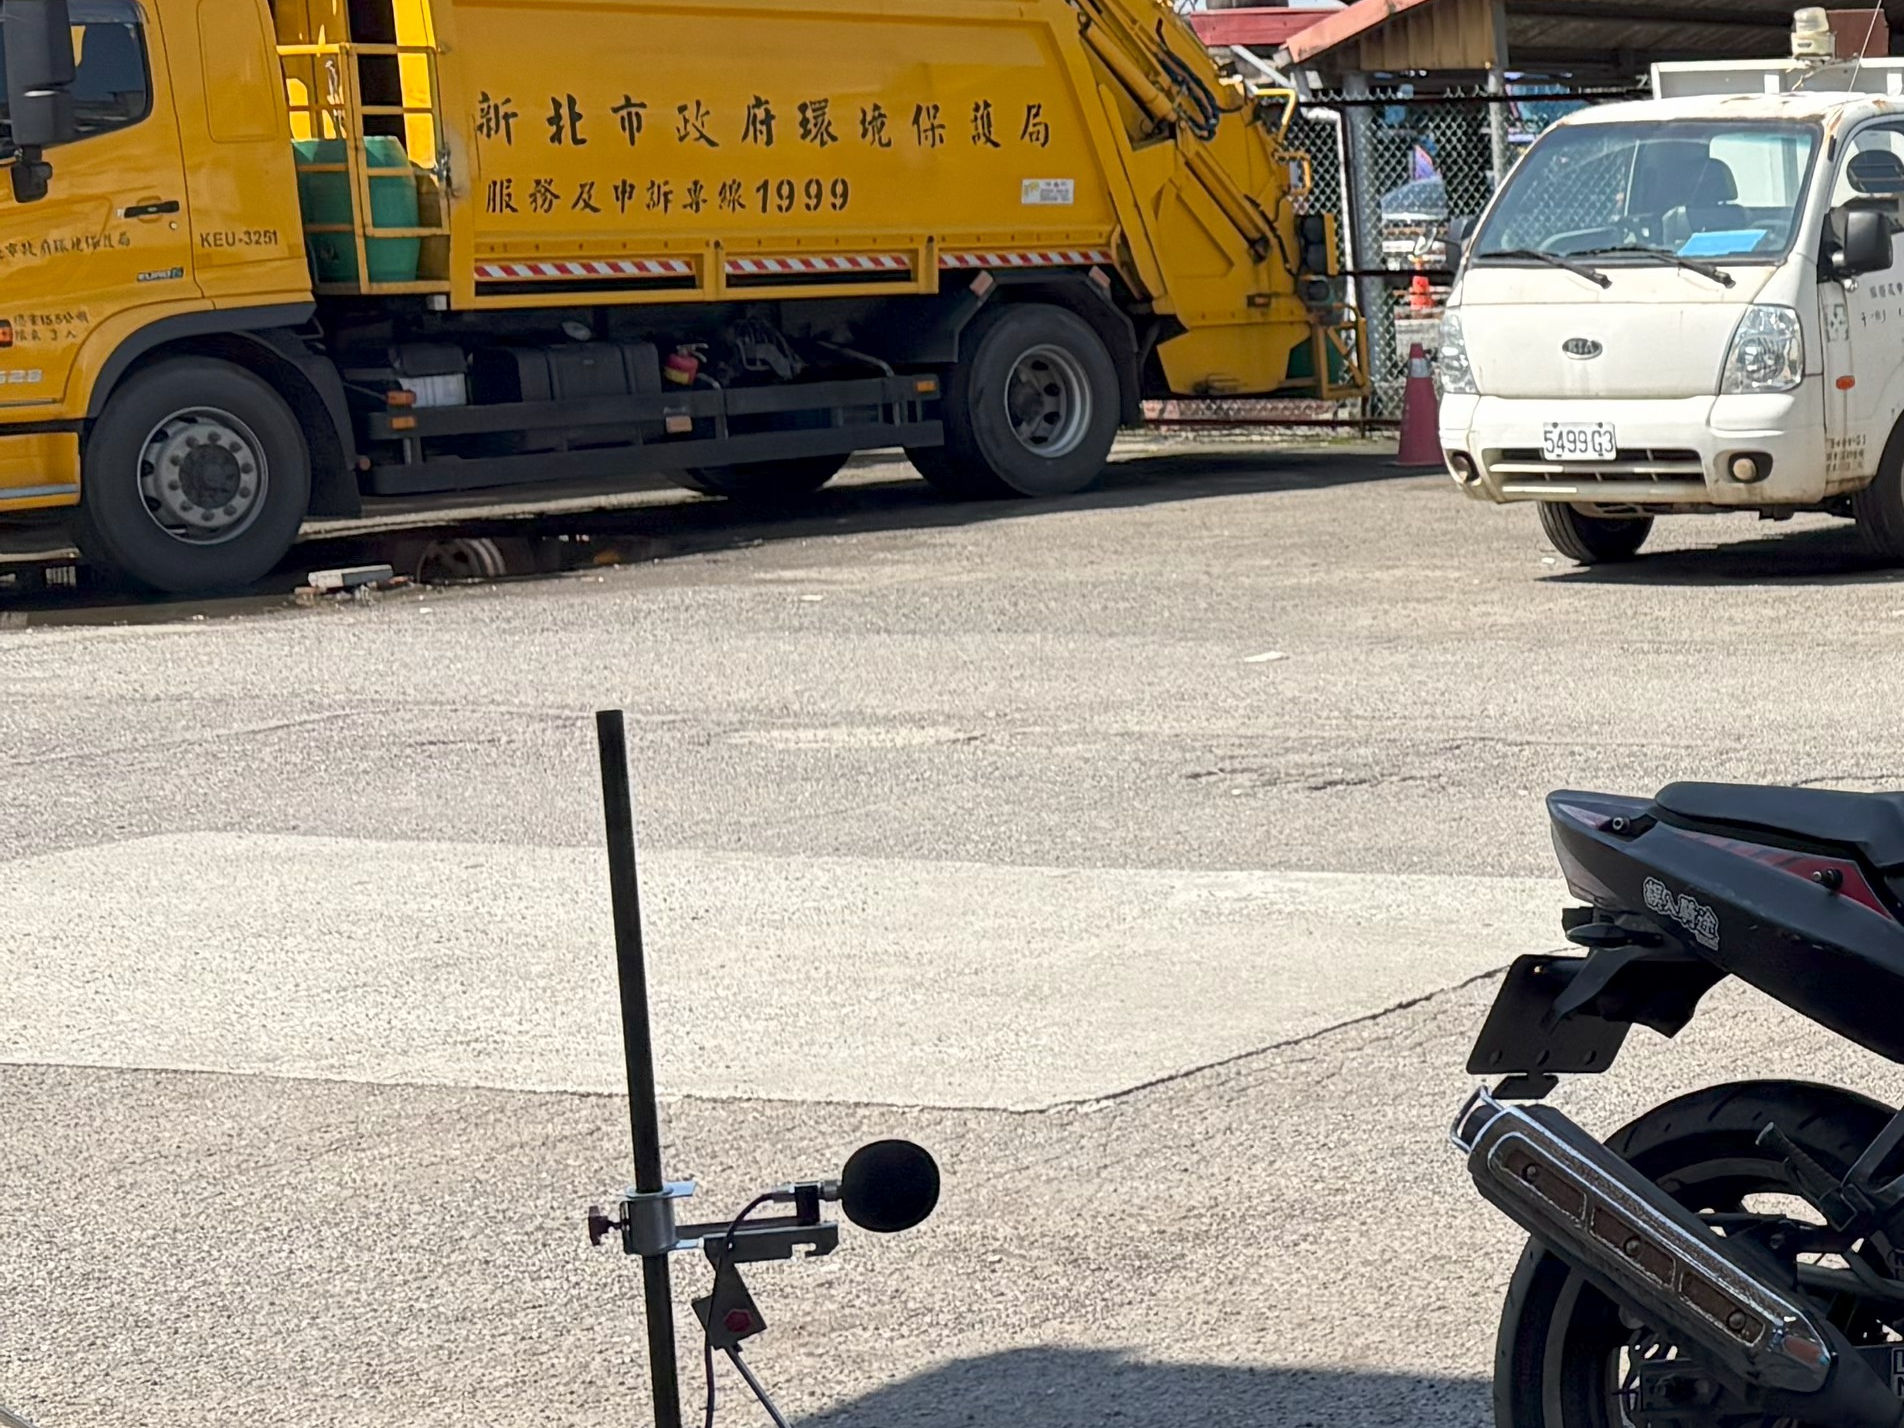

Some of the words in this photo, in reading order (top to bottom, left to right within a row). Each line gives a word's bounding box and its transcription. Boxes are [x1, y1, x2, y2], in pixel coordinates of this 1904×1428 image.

[475, 90, 1051, 149] 新北市政府環境保護局
[201, 229, 278, 248] KEU-3251
[1567, 339, 1596, 354] KIA
